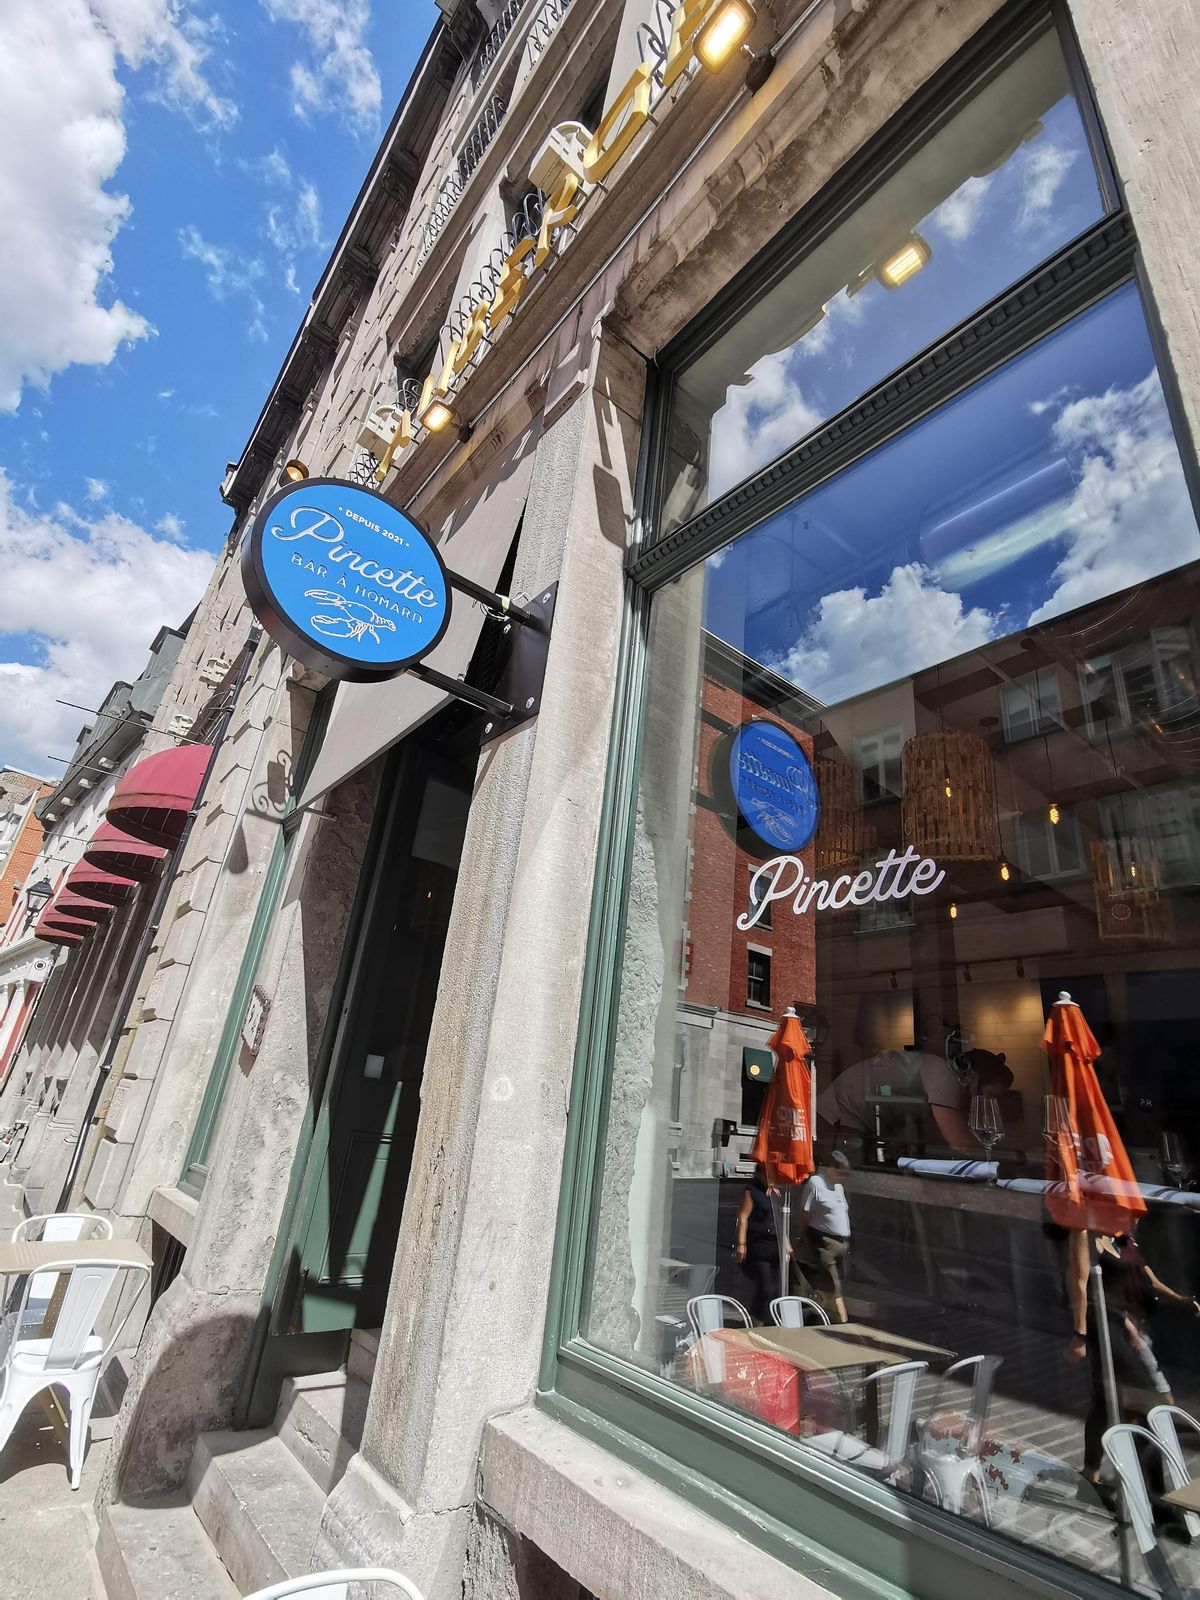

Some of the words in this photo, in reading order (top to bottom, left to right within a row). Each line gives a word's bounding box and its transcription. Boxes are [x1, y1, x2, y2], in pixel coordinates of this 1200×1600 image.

[270, 505, 439, 608] Pincette
[344, 508, 381, 534] DEPUIS
[381, 528, 404, 546] 2021
[290, 551, 329, 579] BAR
[335, 571, 348, 588] À
[354, 582, 423, 625] HOMARD
[736, 844, 946, 931] Pincette
